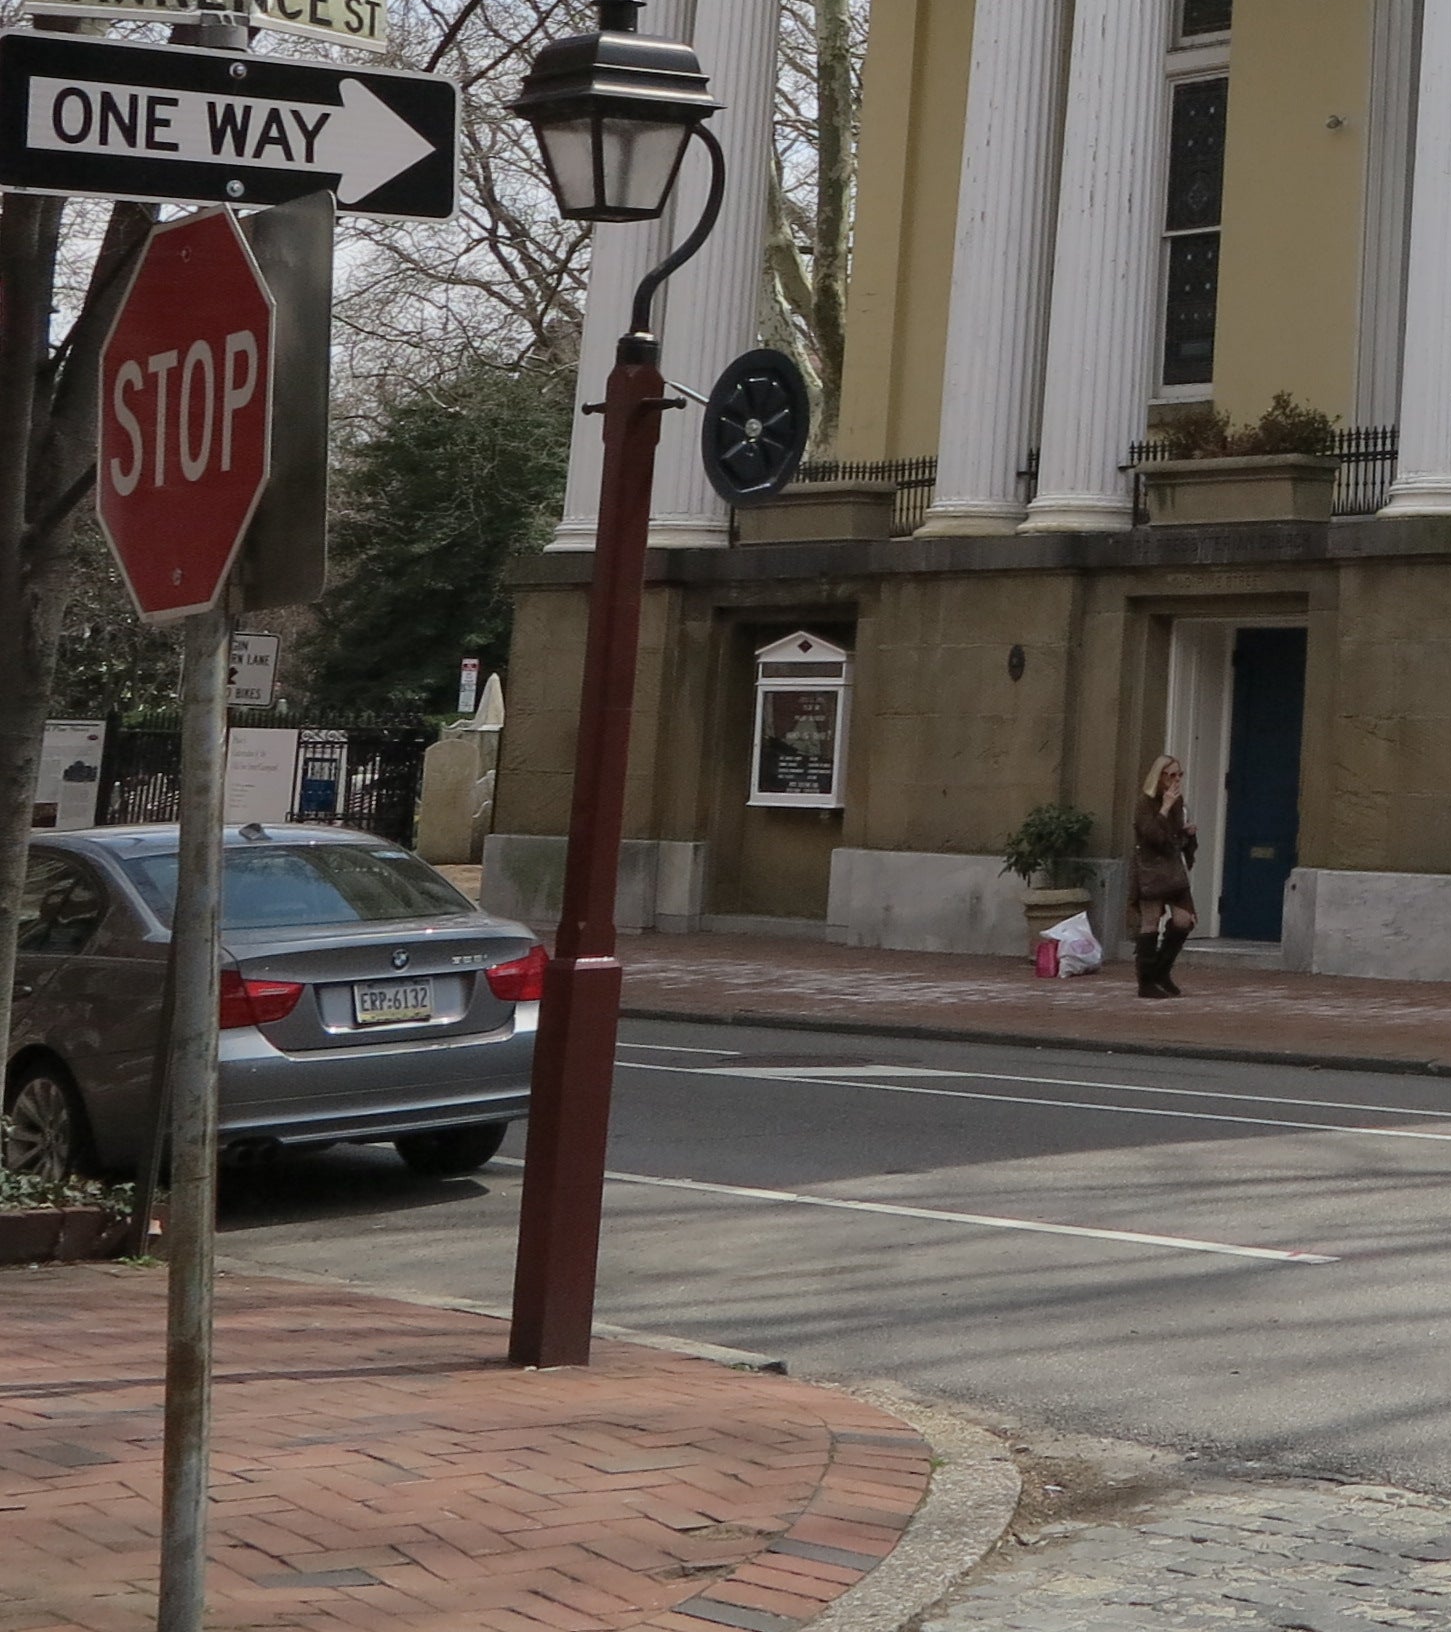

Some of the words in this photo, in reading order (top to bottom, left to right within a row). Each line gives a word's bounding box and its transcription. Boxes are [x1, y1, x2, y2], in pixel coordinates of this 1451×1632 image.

[52, 86, 180, 153] ONE
[207, 100, 332, 164] WAY
[110, 329, 259, 497] STOP
[247, 654, 270, 666] LANE
[235, 688, 261, 699] BIKES
